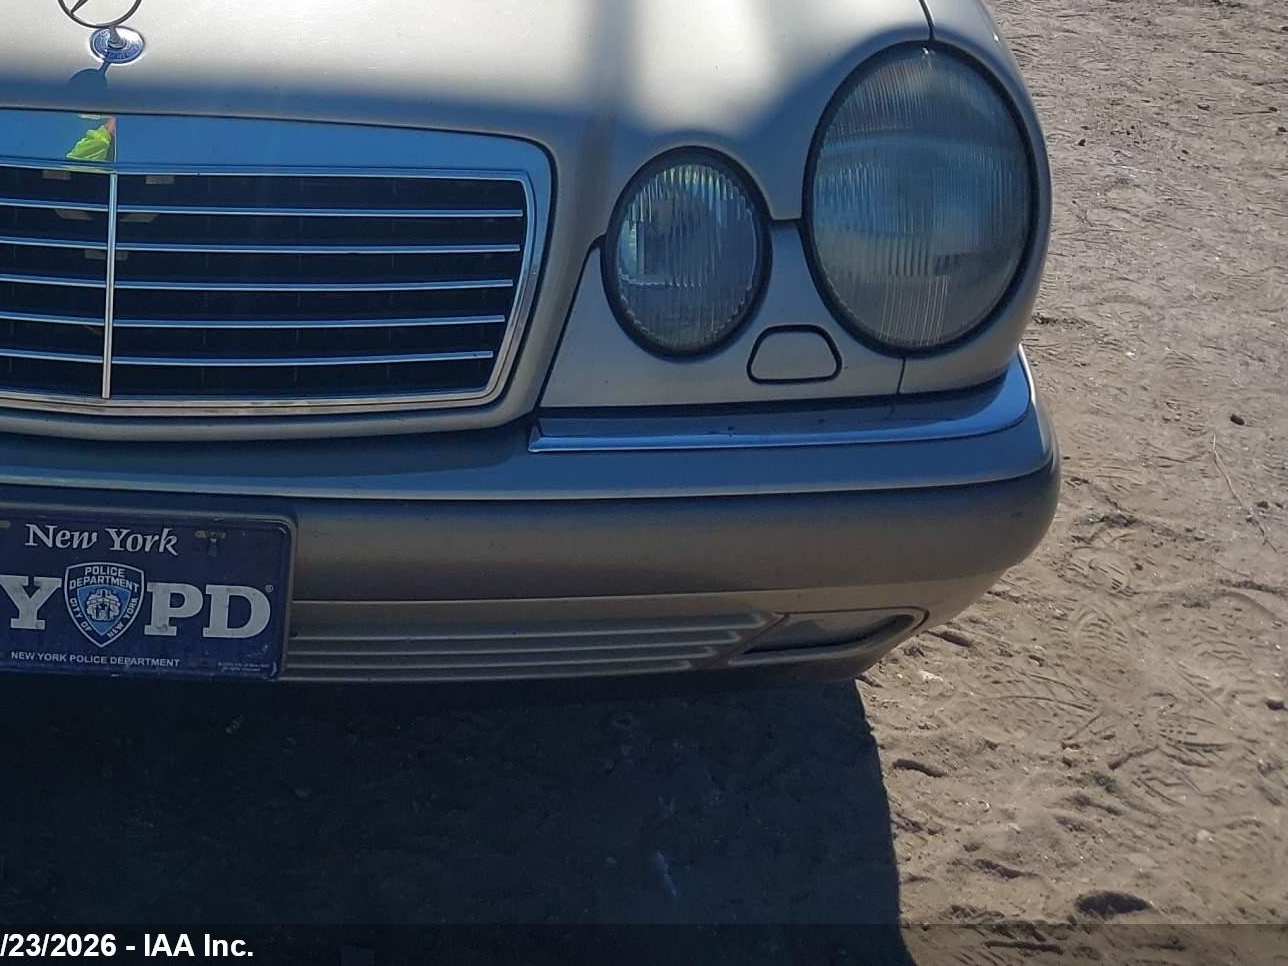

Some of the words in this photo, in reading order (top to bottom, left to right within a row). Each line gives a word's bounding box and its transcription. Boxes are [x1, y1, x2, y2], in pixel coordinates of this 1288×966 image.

[24, 523, 97, 549] New
[105, 528, 179, 556] York
[69, 575, 140, 593] DEPARTMENT
[84, 565, 126, 578] POLICE
[69, 597, 83, 619] CITY
[80, 621, 93, 632] OF
[106, 621, 124, 638] NEW
[123, 597, 139, 620] YORK
[143, 582, 272, 640] PD
[11, 651, 35, 661] NEW
[37, 652, 67, 662] YORK
[69, 654, 108, 664] POLICE
[110, 656, 181, 667] DEPARTMENT
